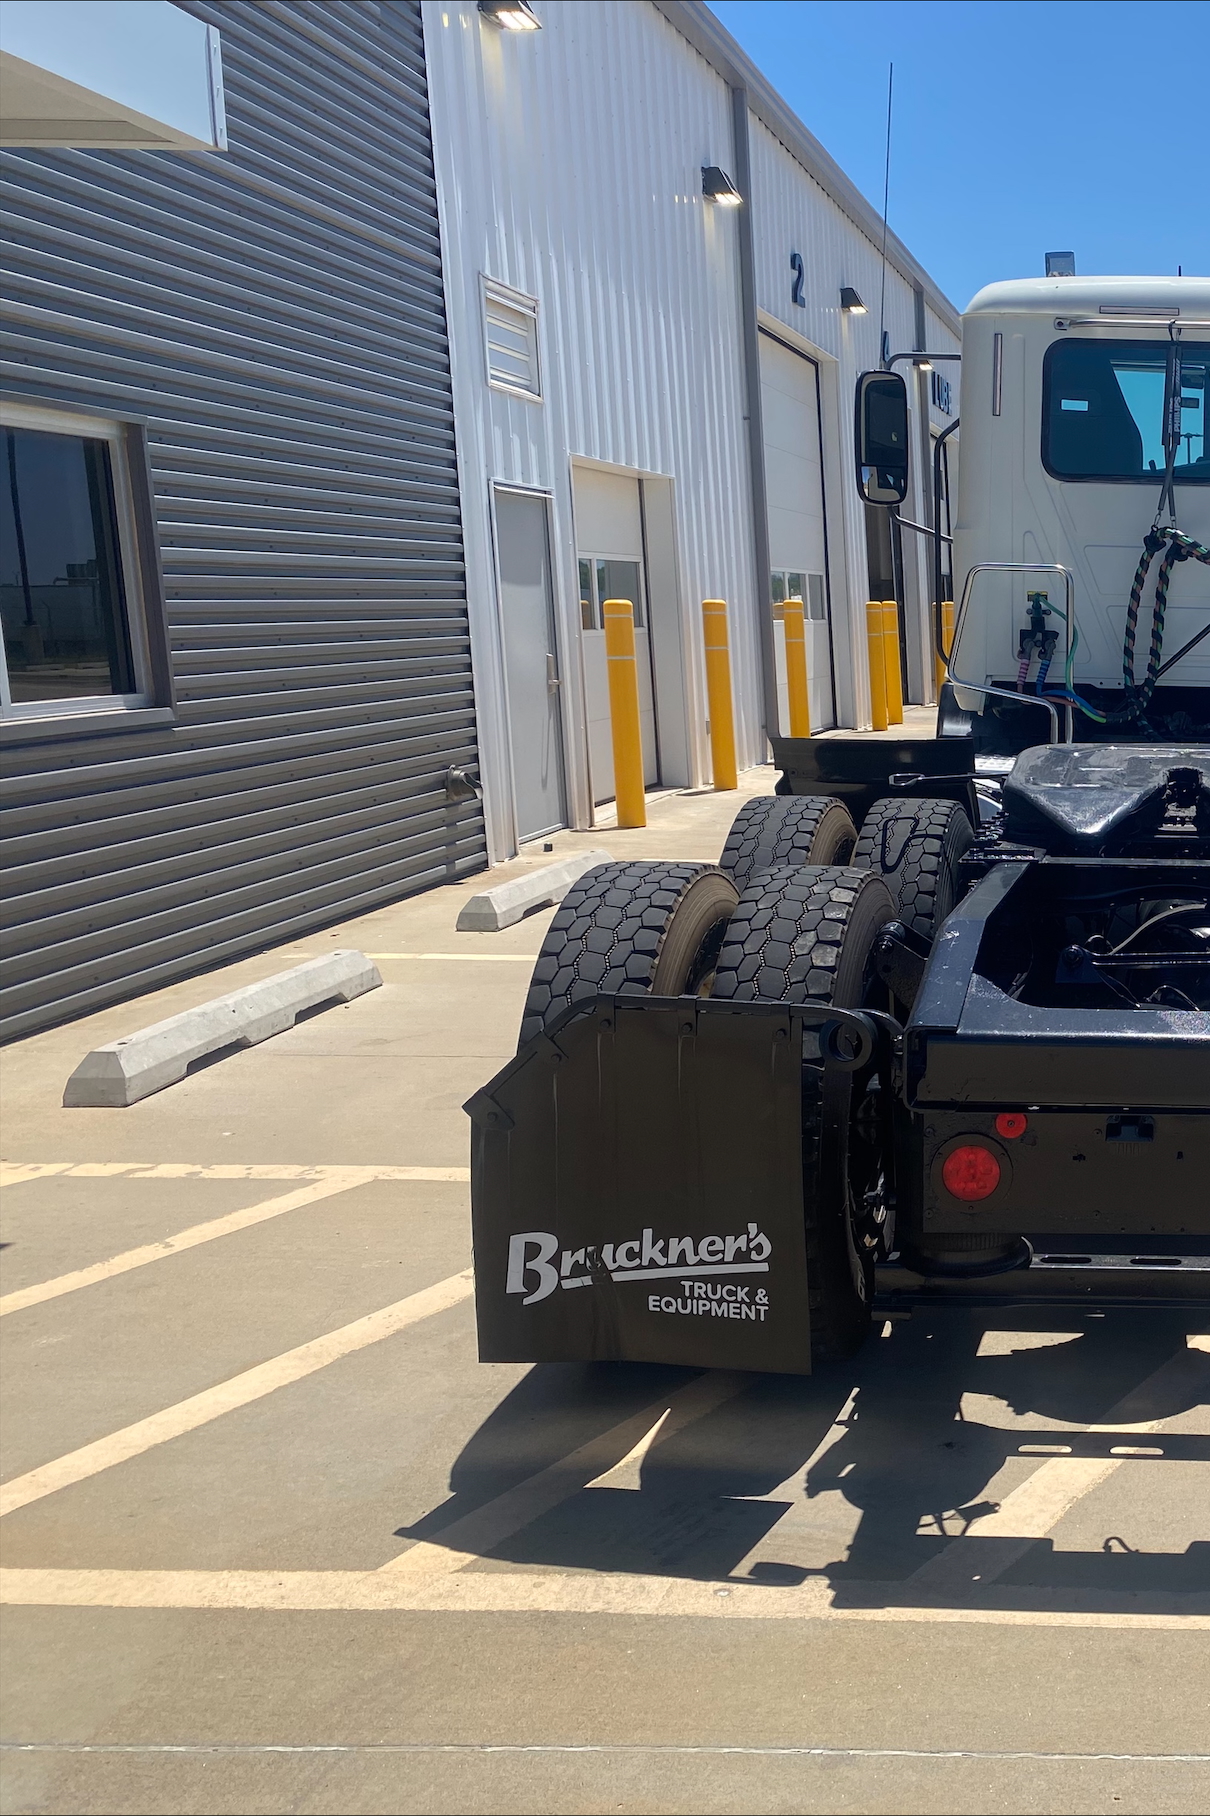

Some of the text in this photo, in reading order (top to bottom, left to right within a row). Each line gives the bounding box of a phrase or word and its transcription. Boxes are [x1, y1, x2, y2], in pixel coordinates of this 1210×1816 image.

[790, 252, 805, 309] 2
[680, 1280, 769, 1305] TRUCK &
[648, 1295, 769, 1322] EQUIPMENT
